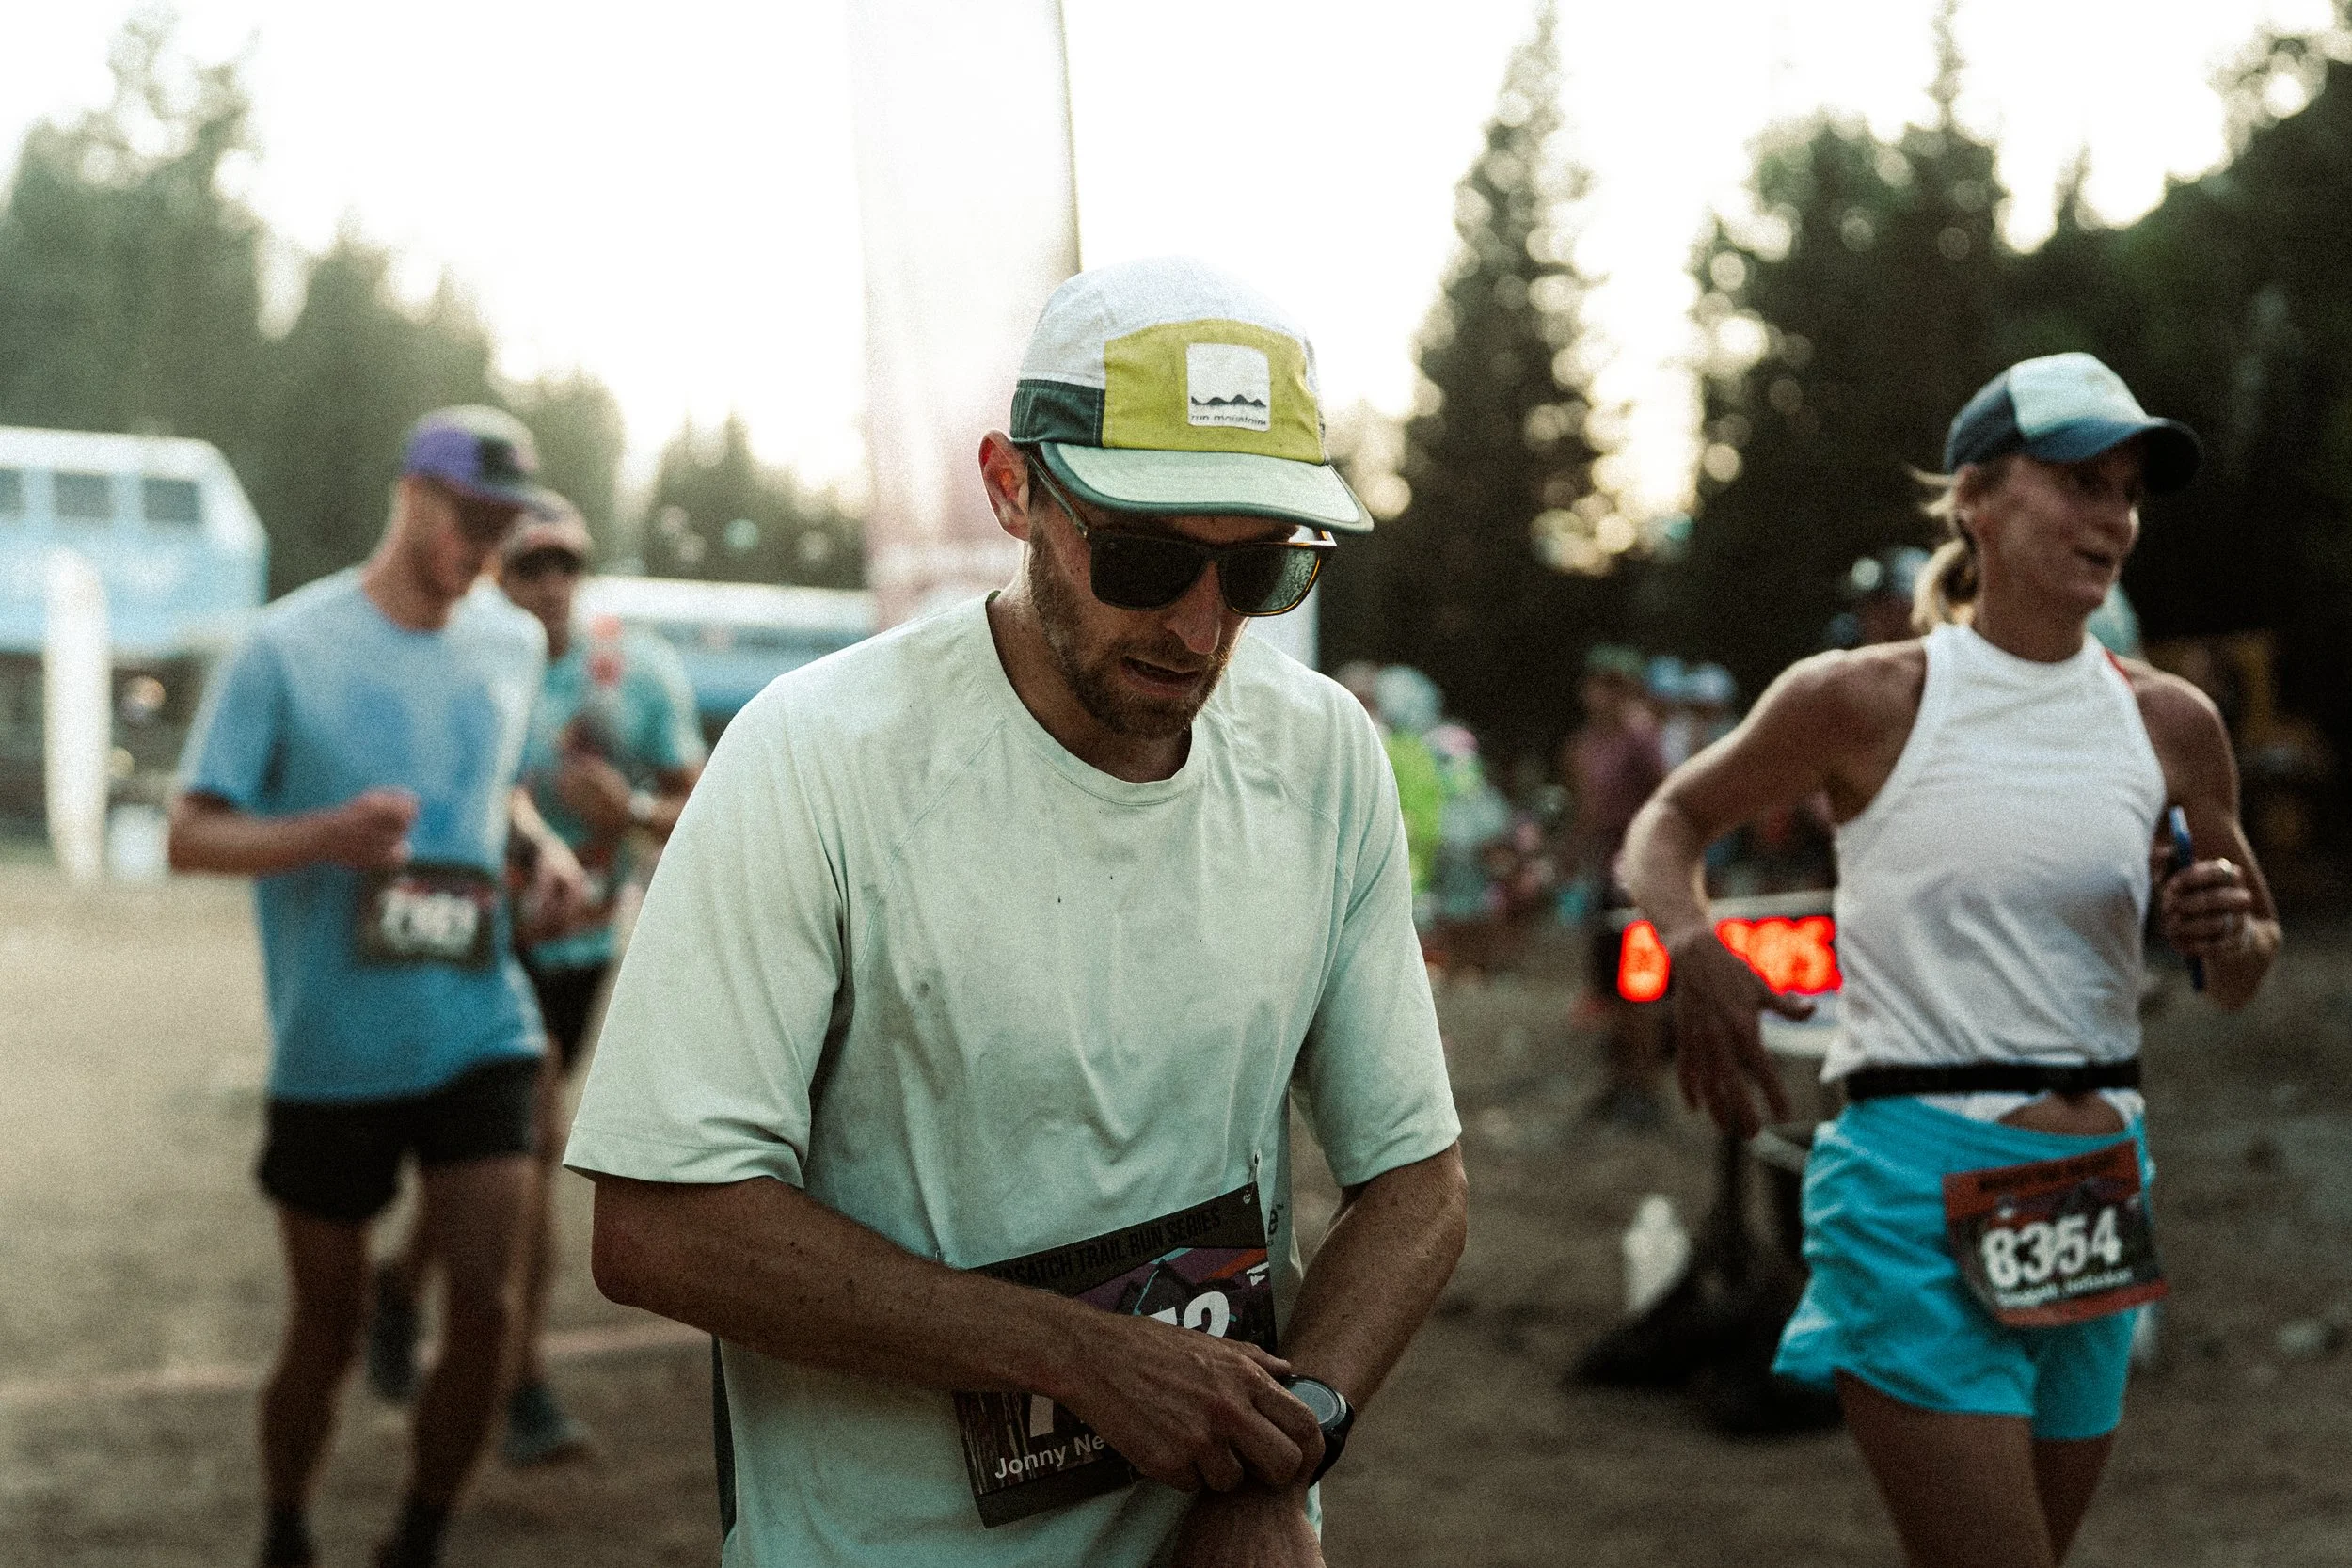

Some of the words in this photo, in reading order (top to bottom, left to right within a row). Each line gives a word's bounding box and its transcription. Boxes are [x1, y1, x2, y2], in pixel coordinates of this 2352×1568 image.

[1077, 1239, 1127, 1273] TRAIL
[1128, 1226, 1166, 1259] RUN
[1167, 1206, 1222, 1244] SERIES
[1981, 1207, 2122, 1288] 8354
[994, 1445, 1067, 1480] Jonny
